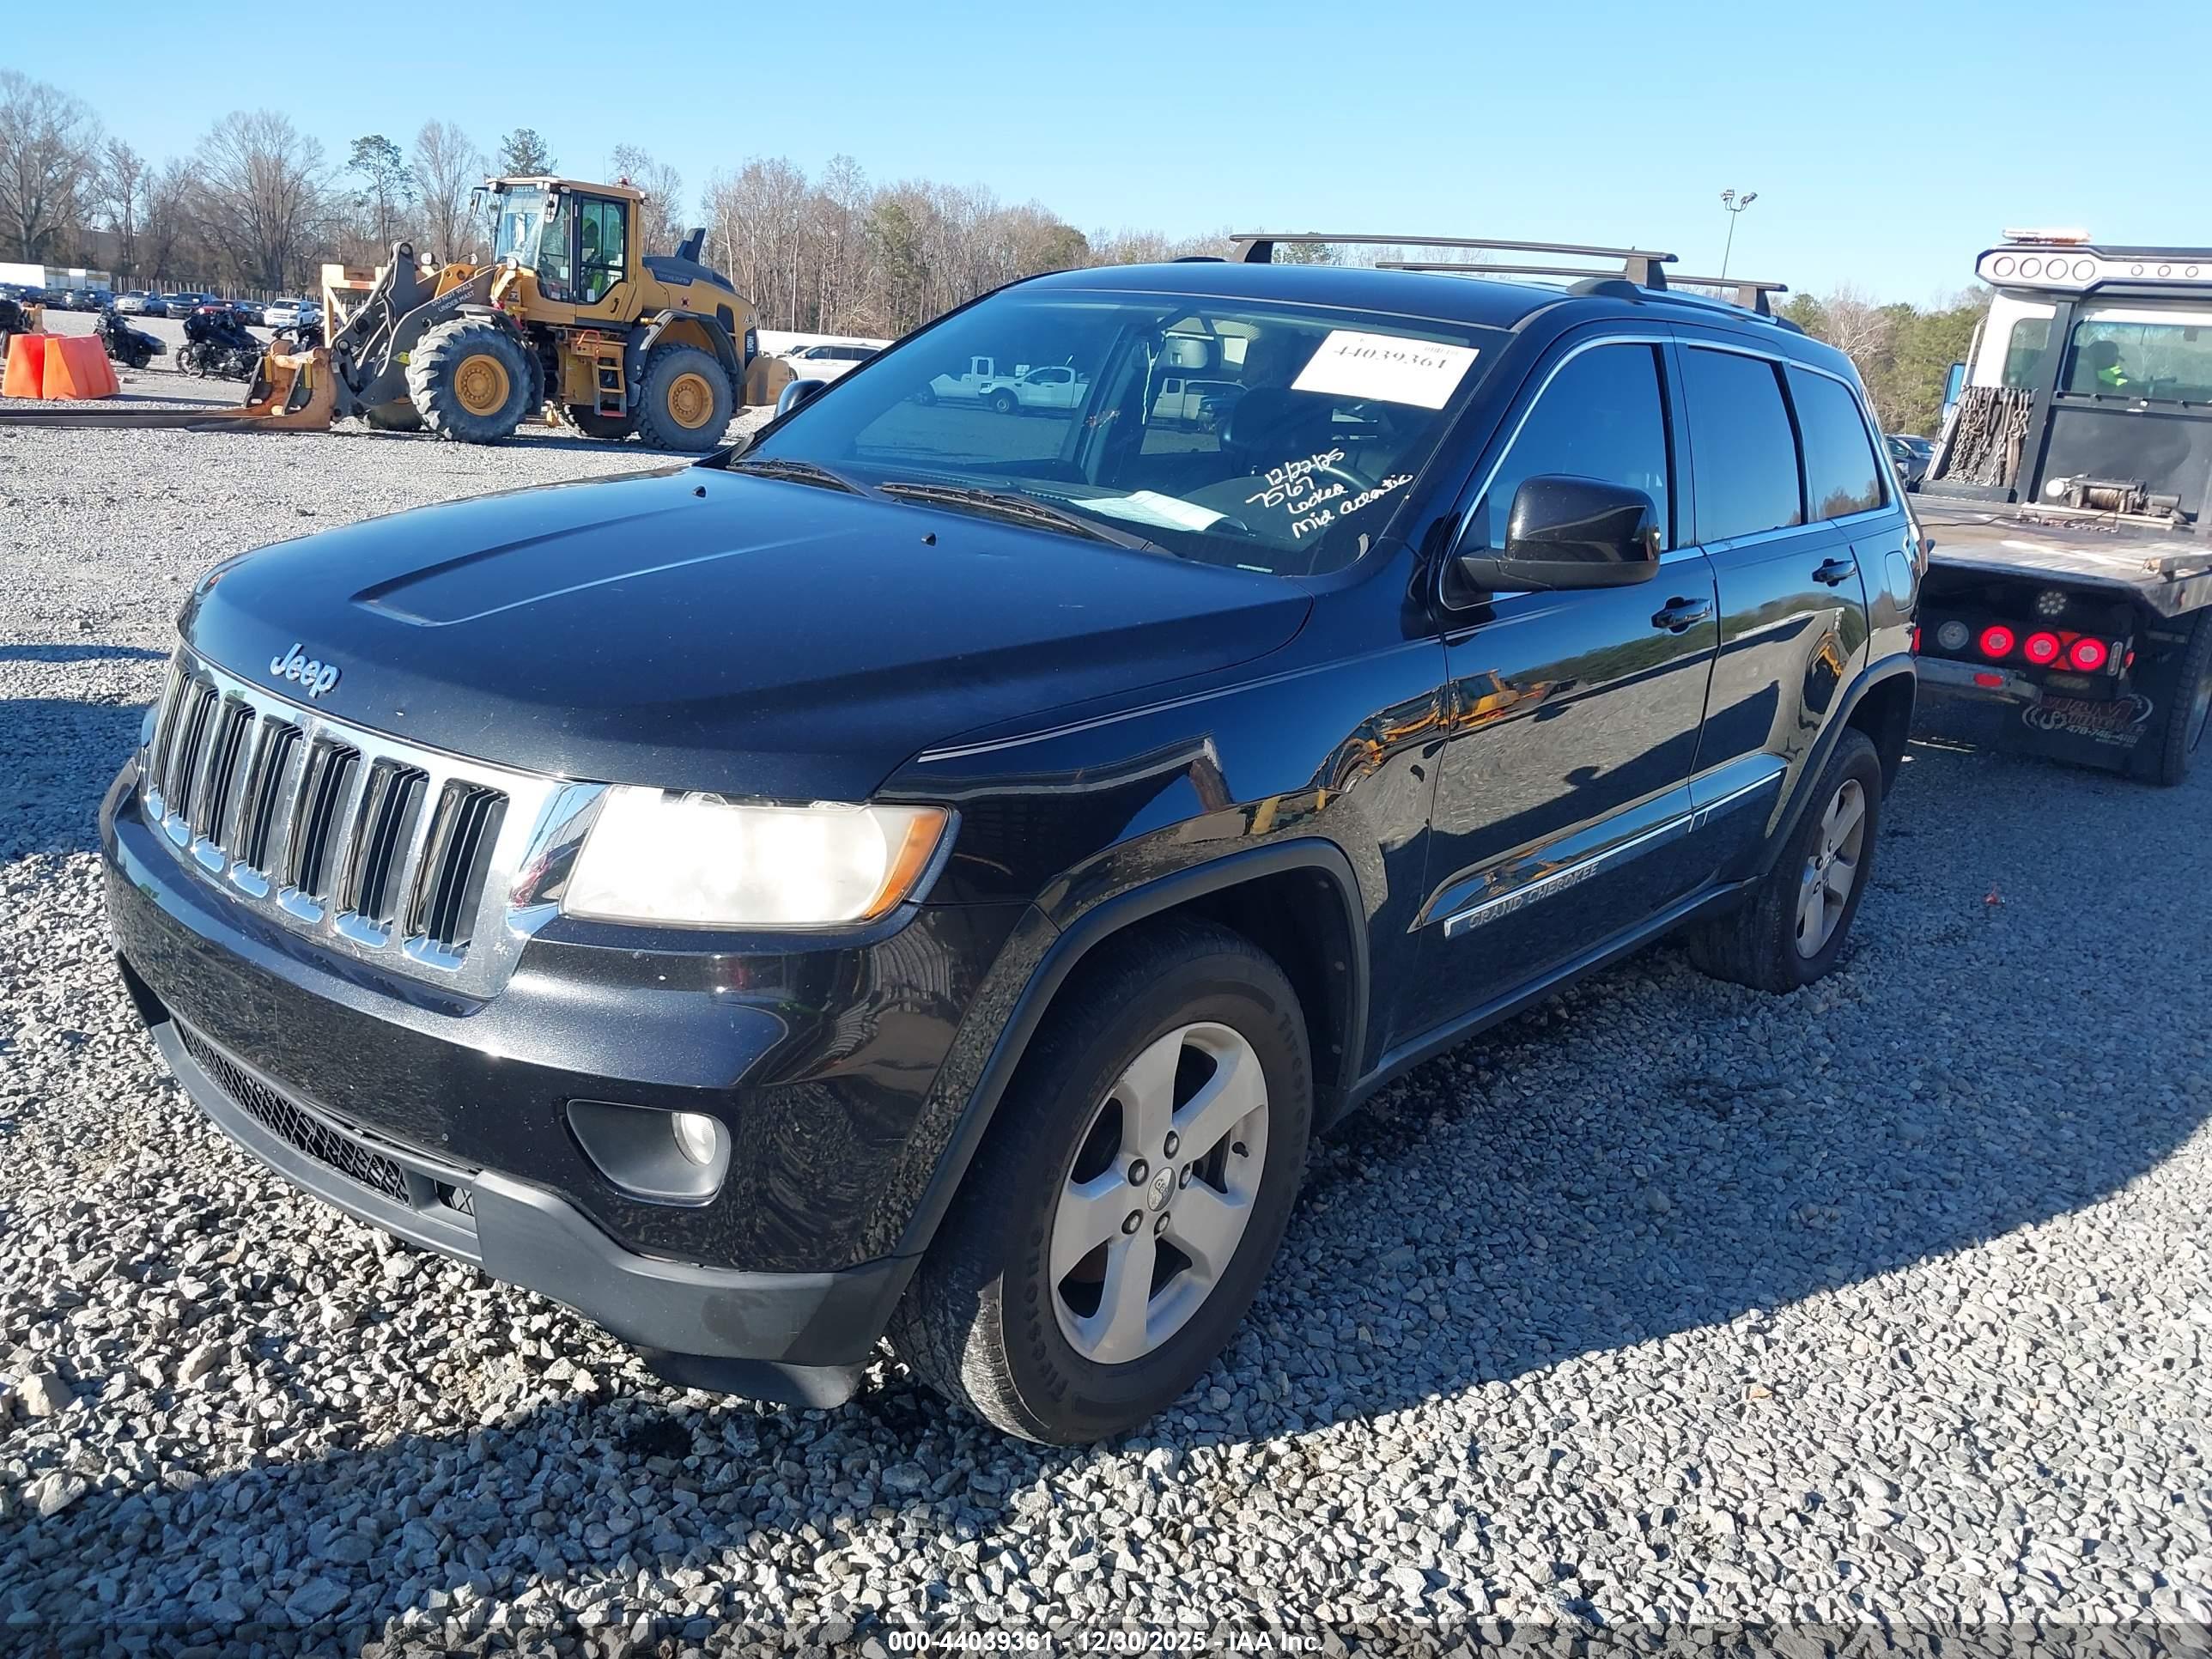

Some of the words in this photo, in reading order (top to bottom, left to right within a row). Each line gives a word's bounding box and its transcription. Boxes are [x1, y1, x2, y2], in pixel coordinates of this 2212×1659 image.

[512, 185, 535, 193] VOLVO
[438, 298, 459, 313] UNDER
[459, 289, 475, 302] MAST
[441, 290, 456, 301] NOT
[456, 281, 475, 294] WALK
[1334, 345, 1448, 369] 44039361
[1265, 447, 1346, 486] 12/22/25
[270, 642, 341, 697] Jeep
[1468, 896, 1523, 929] GRAND
[1527, 861, 1601, 903] CHEROKEE
